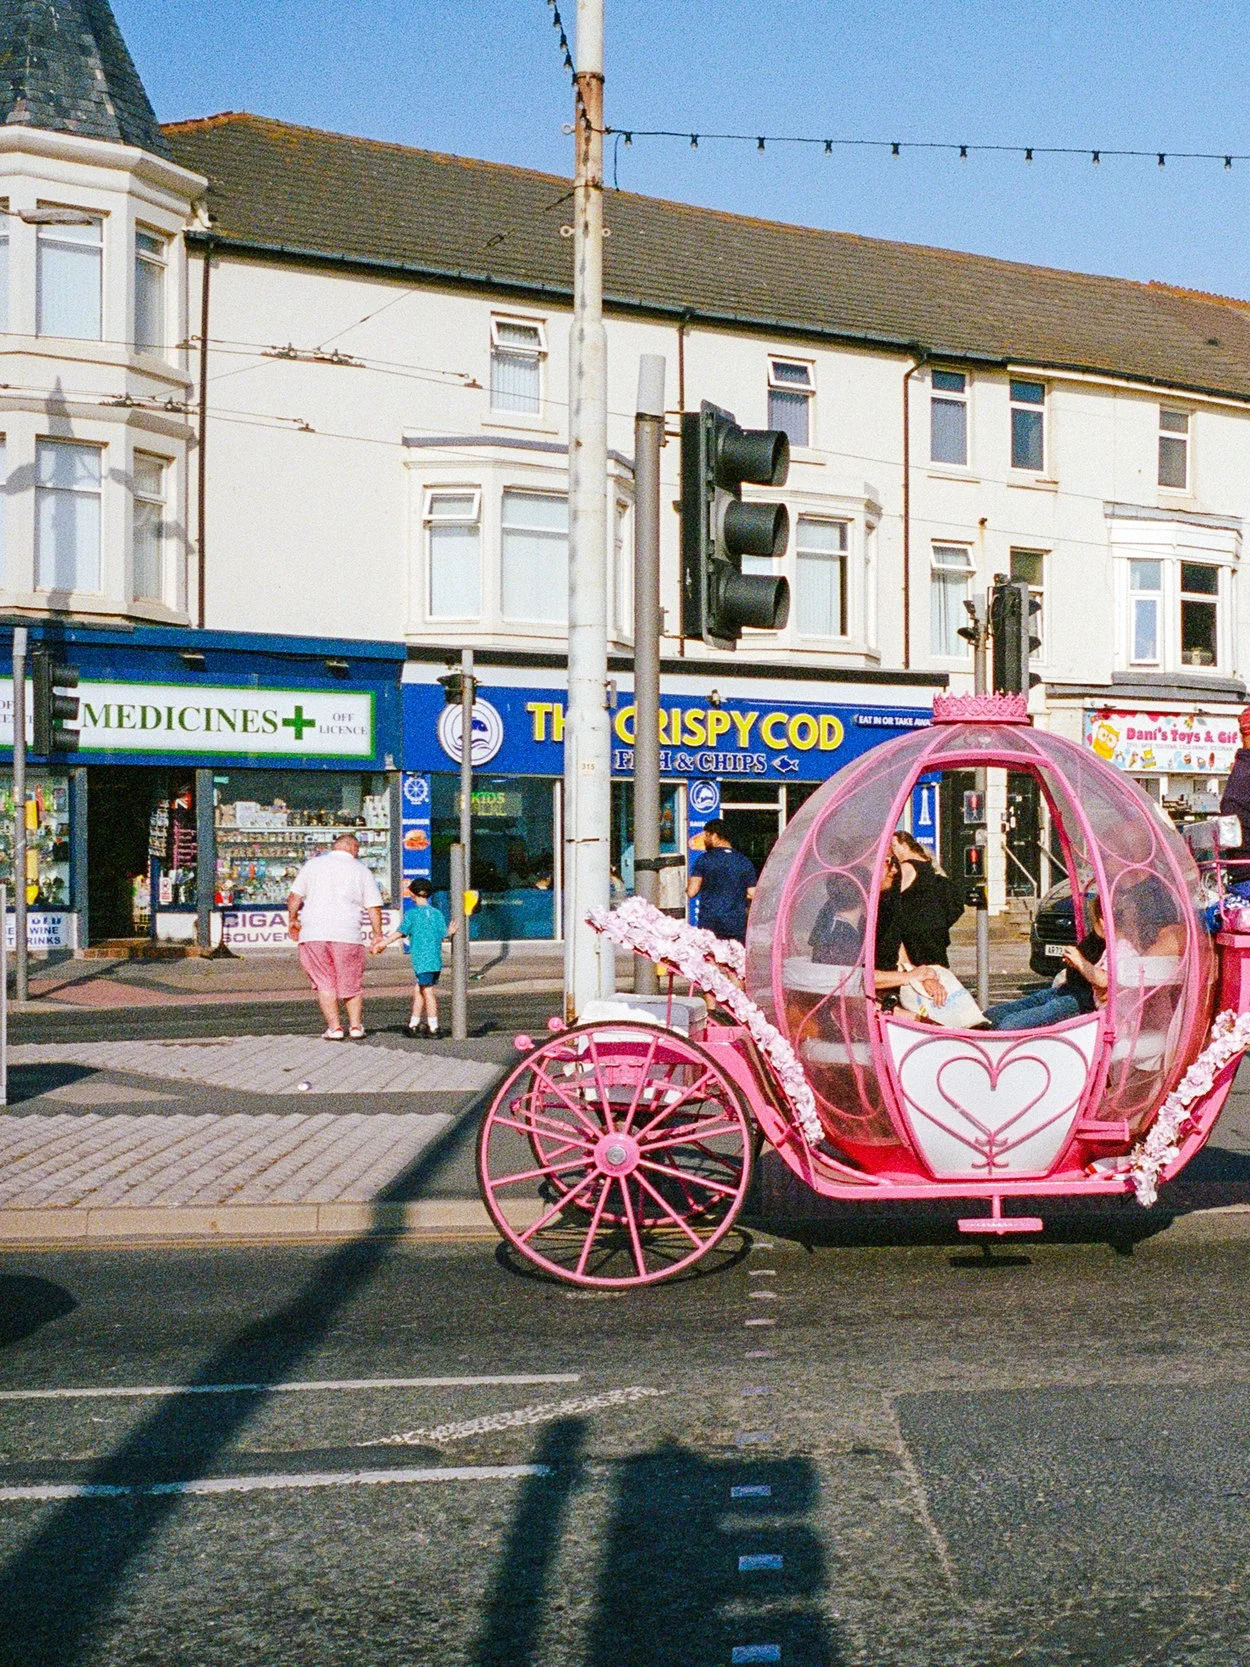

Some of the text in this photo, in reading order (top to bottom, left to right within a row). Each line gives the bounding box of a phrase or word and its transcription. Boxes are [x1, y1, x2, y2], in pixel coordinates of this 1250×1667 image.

[82, 703, 278, 734] MEDICINES
[332, 712, 355, 722] OFF
[859, 715, 873, 725] EAT
[883, 716, 894, 726] OR
[895, 717, 913, 726] TAKE
[914, 718, 933, 727] AWA
[319, 725, 367, 735] LICENCE
[526, 702, 566, 742] TH
[761, 711, 845, 751] COD
[1126, 727, 1238, 744] Dani's Toys & Gif
[614, 749, 768, 773] FH & CHIPS
[30, 926, 59, 934] WINE
[27, 937, 61, 945] RINKS
